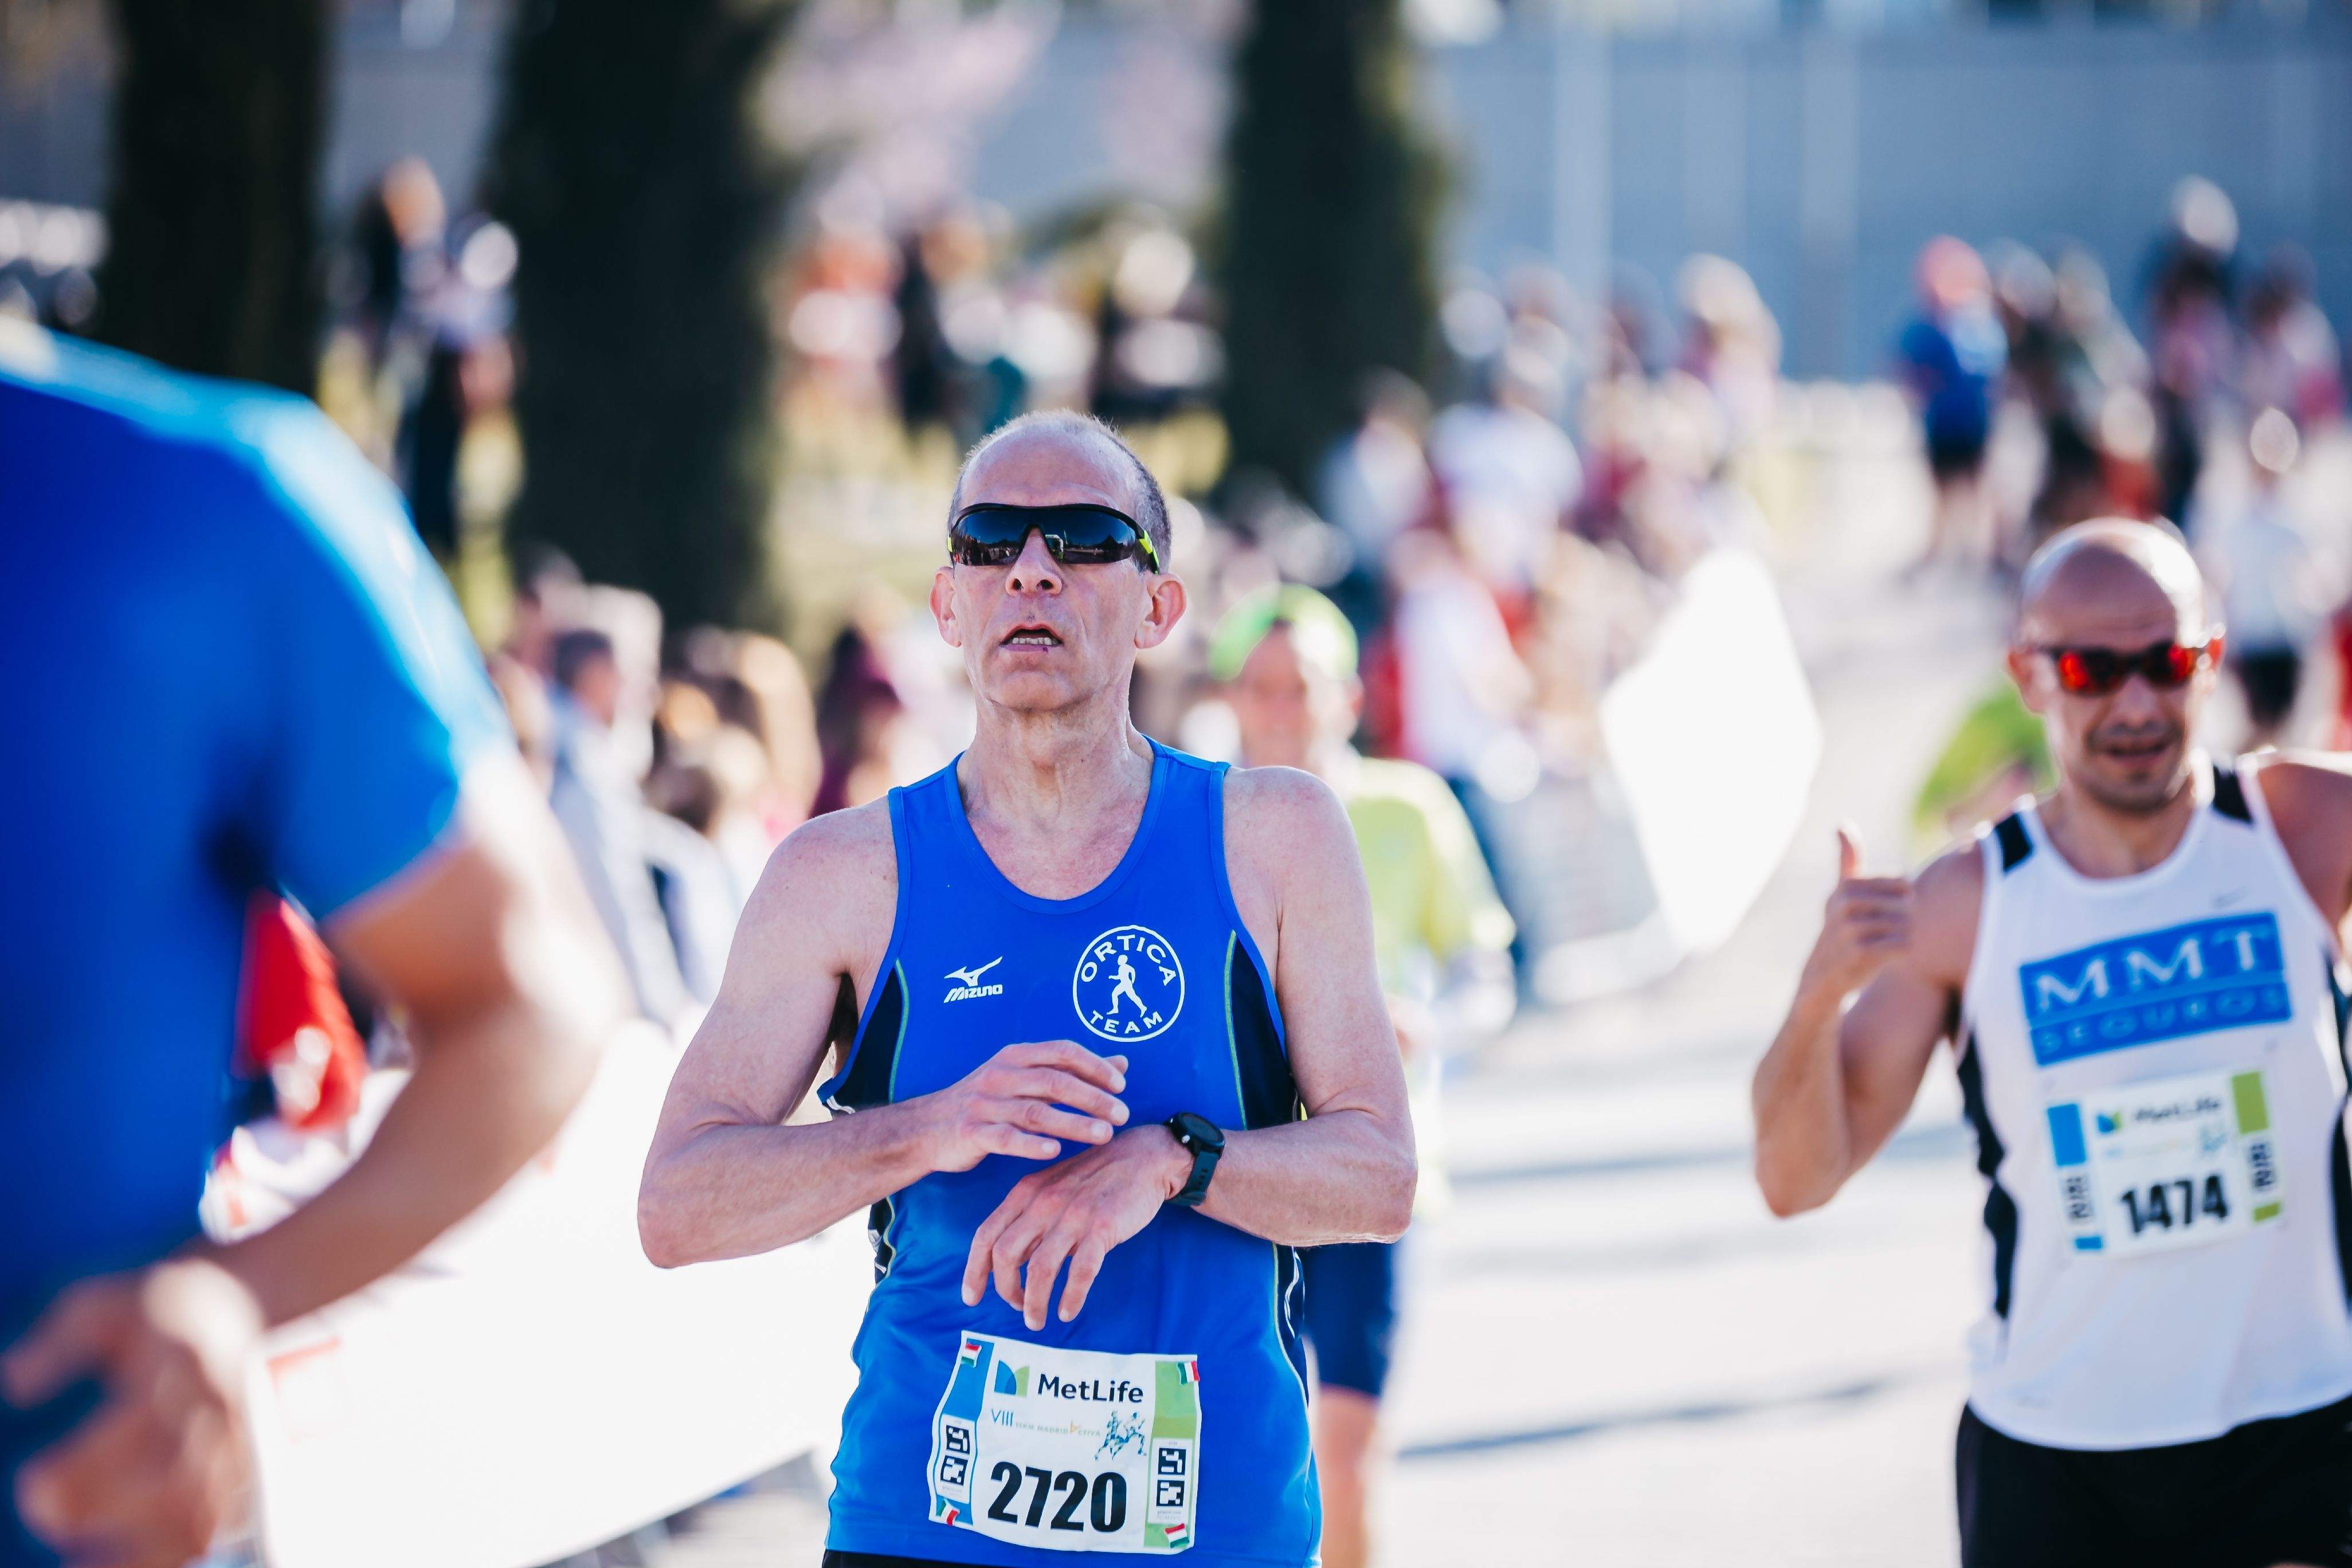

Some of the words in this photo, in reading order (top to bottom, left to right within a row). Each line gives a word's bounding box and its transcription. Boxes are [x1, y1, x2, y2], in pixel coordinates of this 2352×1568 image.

[1081, 934, 1177, 986] ORTICA
[2037, 926, 2272, 1011] MMT
[1089, 1010, 1163, 1034] TEAM
[2120, 1174, 2229, 1234] 1474
[1038, 1374, 1143, 1403] MetLife
[991, 1408, 1014, 1428] VIII
[988, 1461, 1127, 1532] 2720
